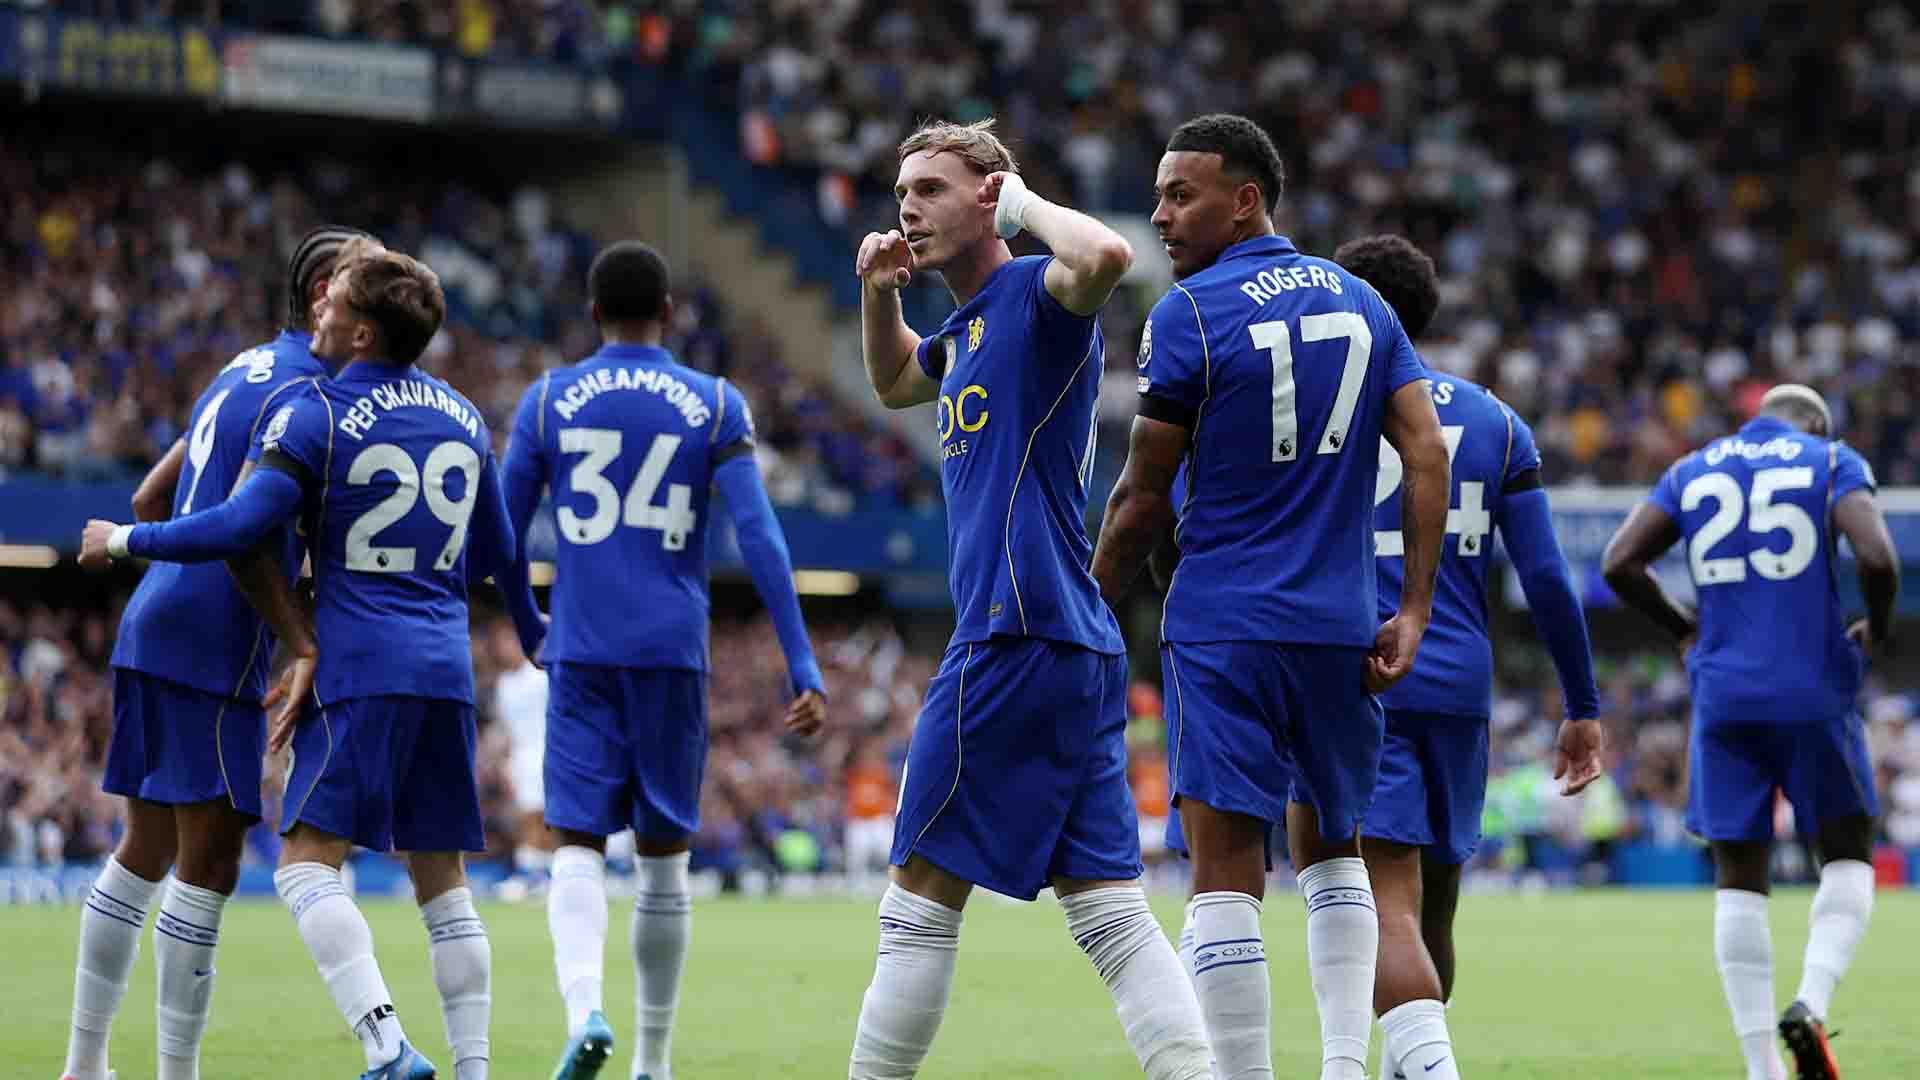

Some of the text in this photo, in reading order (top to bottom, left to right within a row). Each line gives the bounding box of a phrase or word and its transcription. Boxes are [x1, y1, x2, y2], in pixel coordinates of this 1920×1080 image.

[1240, 265, 1343, 307] ROGERS
[339, 379, 479, 440] PEP CHAVARRIA
[554, 367, 711, 428] ACHEAMPONG
[1248, 312, 1372, 462] 17
[345, 441, 481, 572] 29
[557, 428, 697, 551] 34
[1681, 466, 1818, 586] 25
